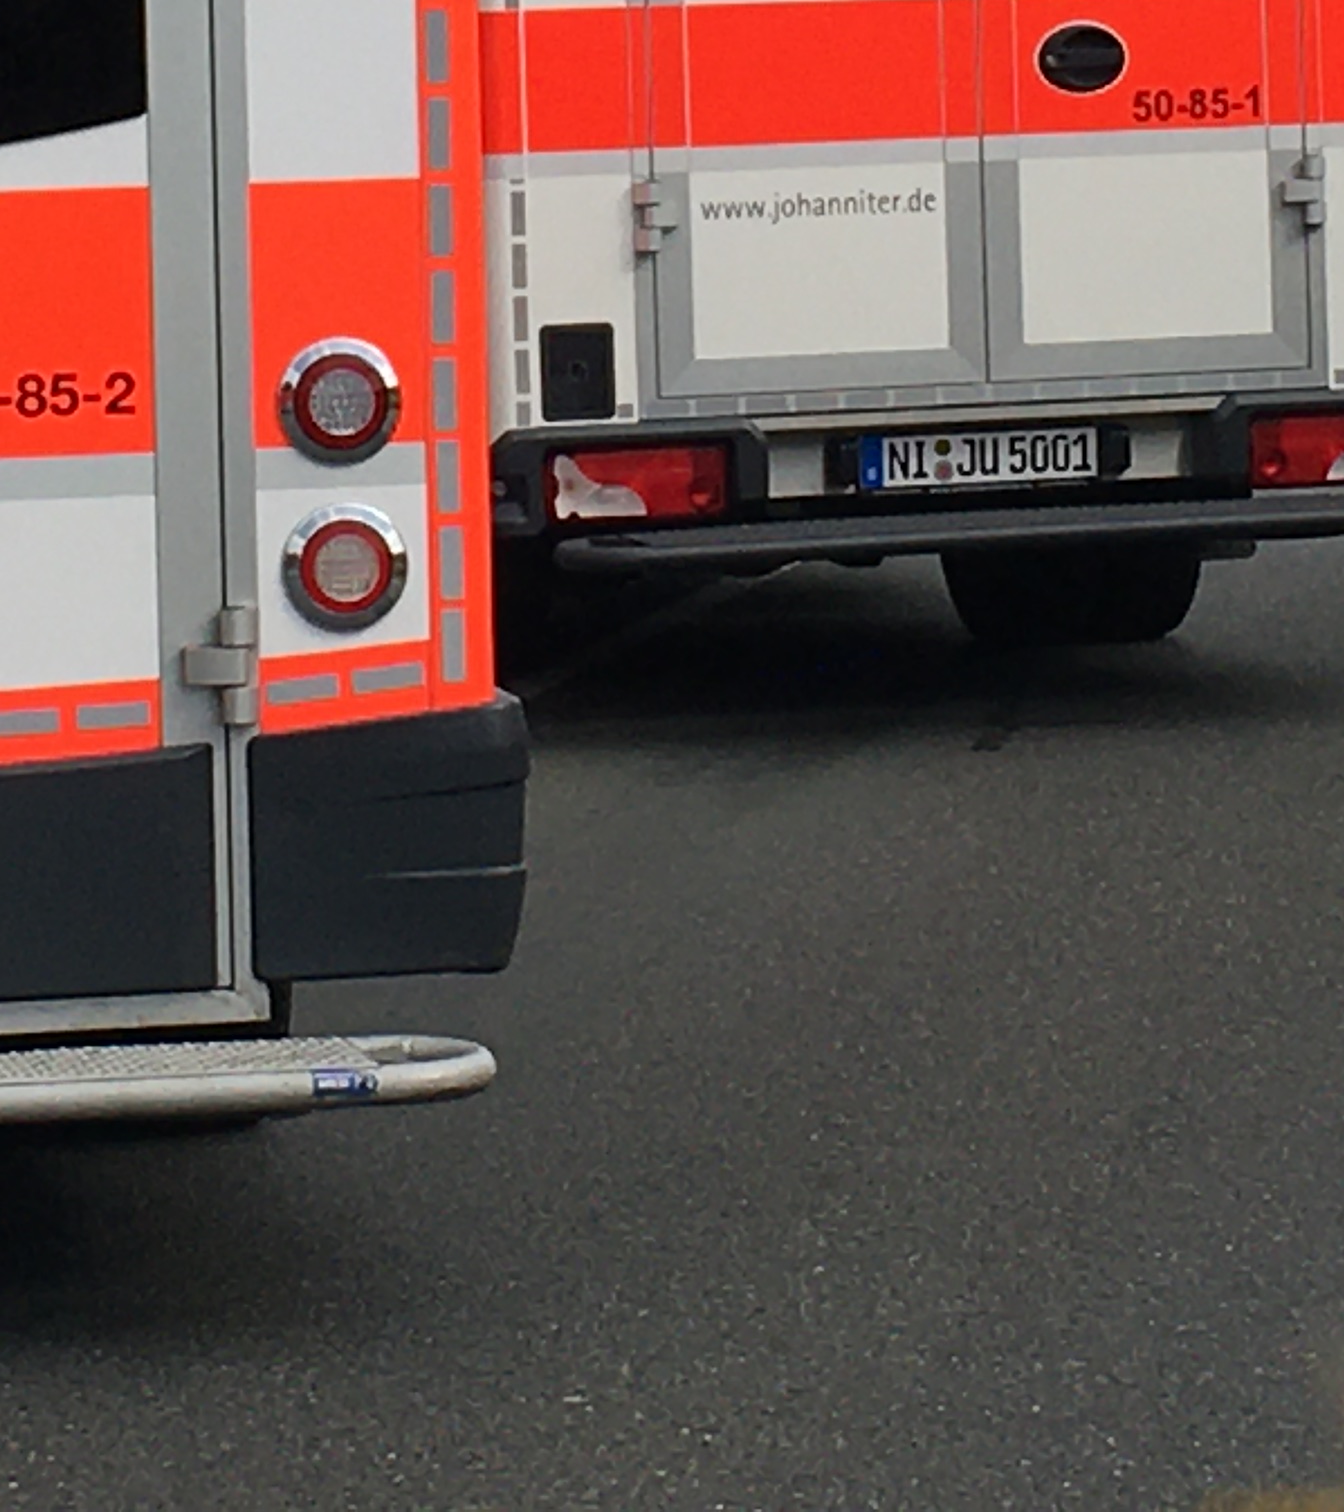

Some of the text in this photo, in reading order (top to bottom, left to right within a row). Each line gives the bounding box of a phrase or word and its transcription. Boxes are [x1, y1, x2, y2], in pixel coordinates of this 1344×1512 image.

[1131, 85, 1262, 123] 50-85-1
[700, 188, 939, 226] www.johanniter.de
[888, 433, 1092, 481] NI JU 5001
